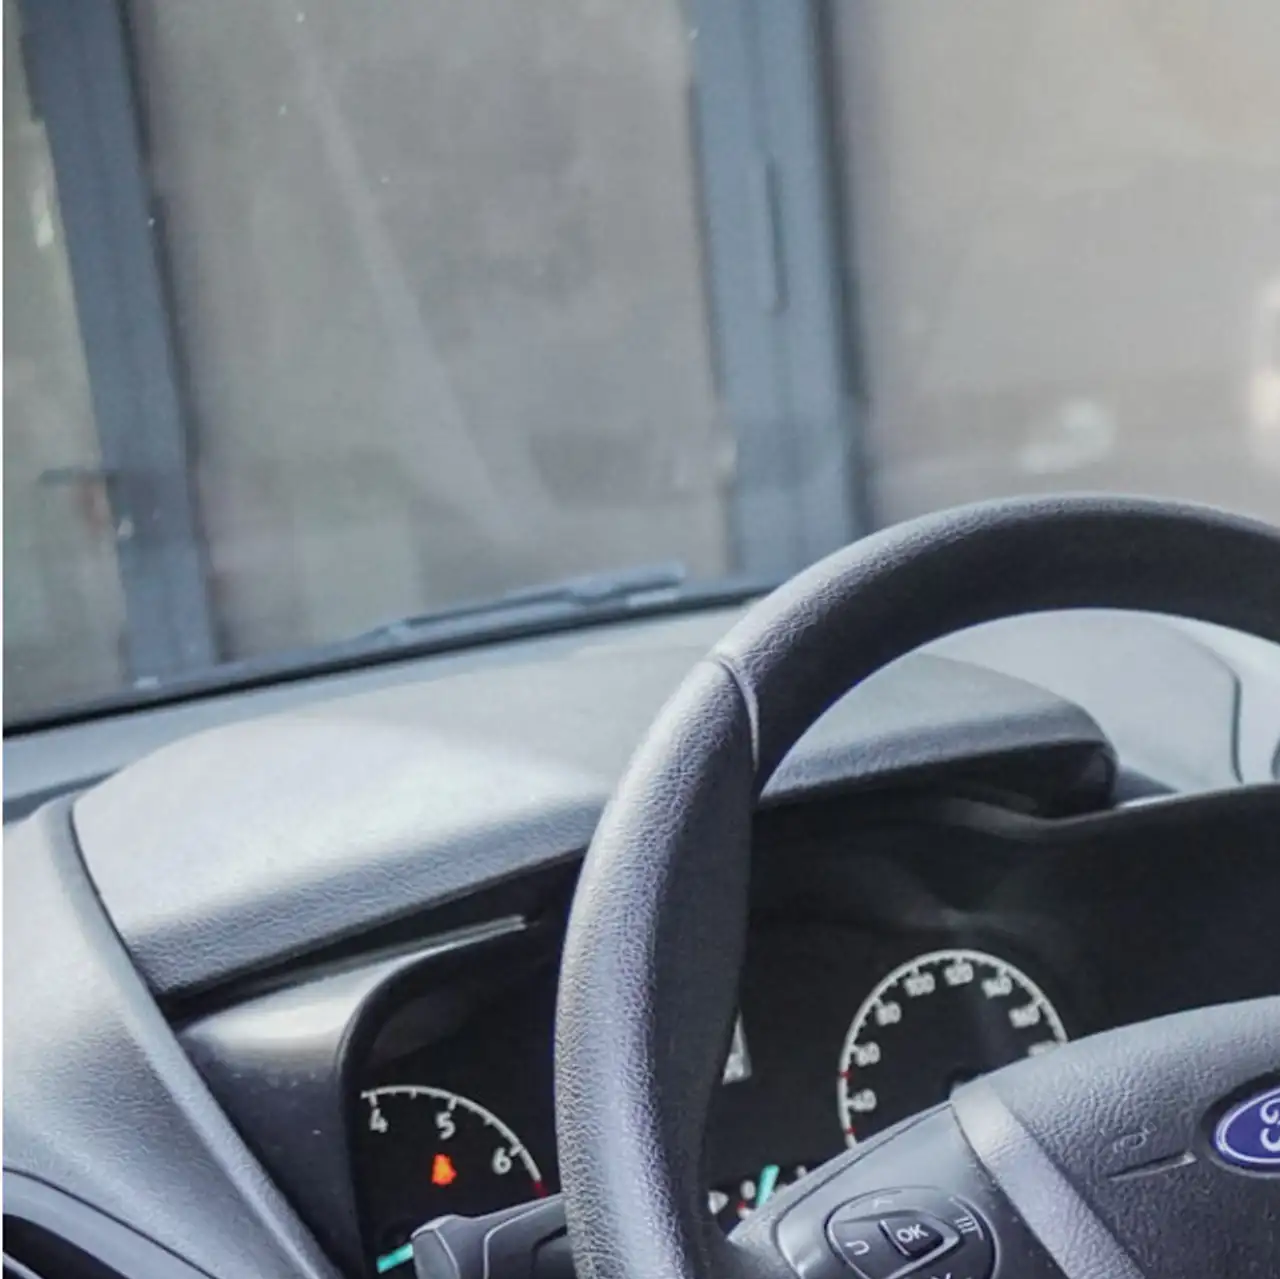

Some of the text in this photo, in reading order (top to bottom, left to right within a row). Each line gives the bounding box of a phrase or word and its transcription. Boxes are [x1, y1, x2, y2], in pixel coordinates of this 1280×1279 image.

[369, 1108, 389, 1133] 4
[435, 1110, 456, 1141] 5
[492, 1146, 513, 1176] 6
[896, 1222, 930, 1244] OK
